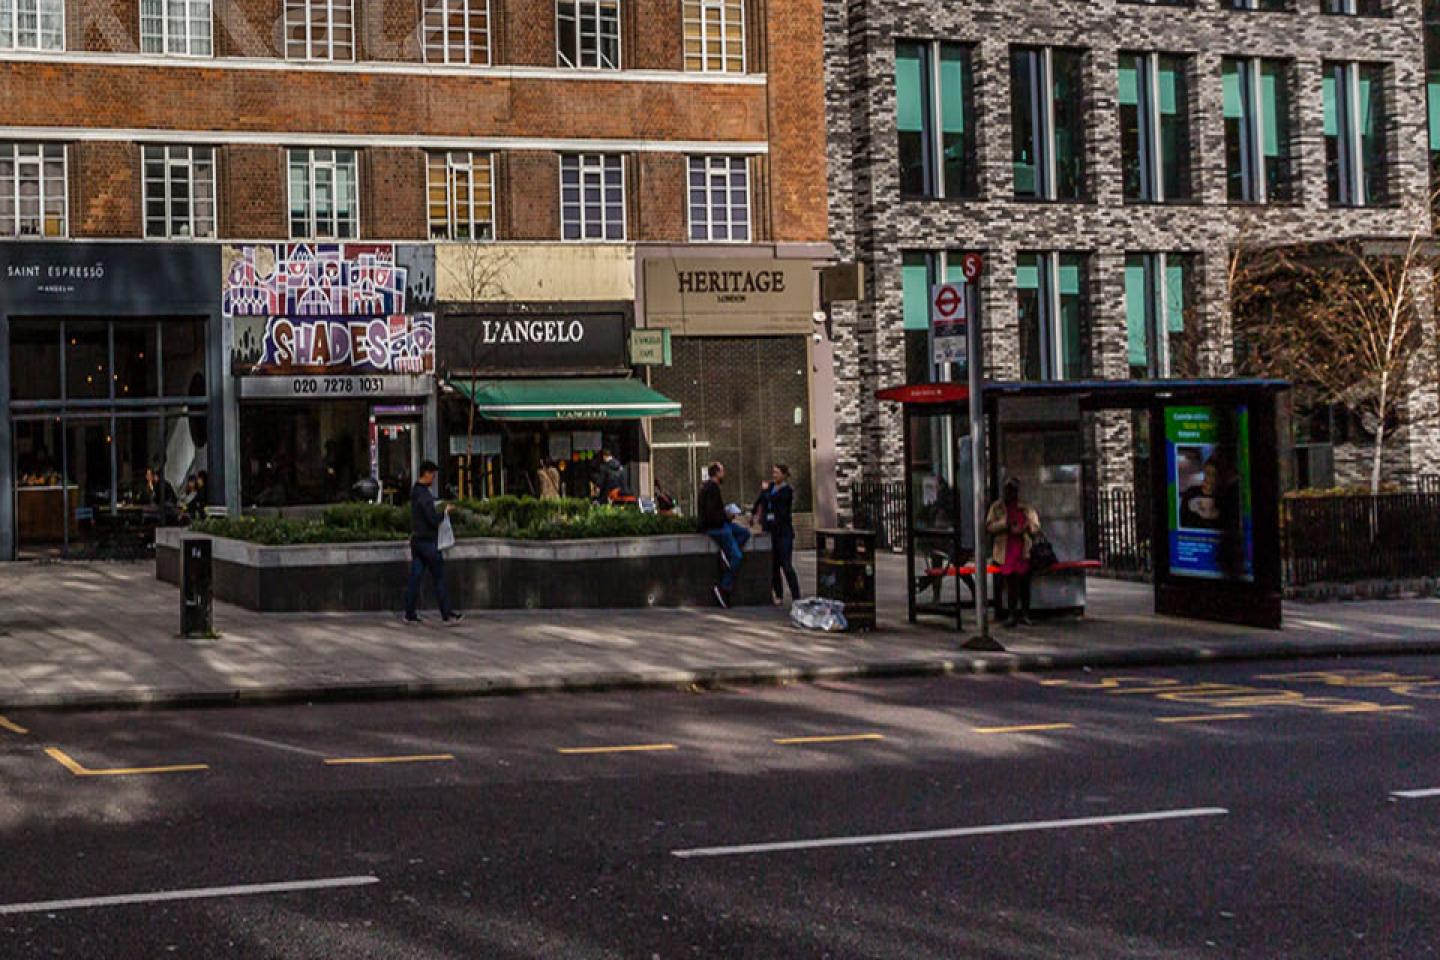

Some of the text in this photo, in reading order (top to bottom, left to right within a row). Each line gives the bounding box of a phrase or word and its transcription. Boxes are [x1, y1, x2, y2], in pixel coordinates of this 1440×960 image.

[7, 265, 40, 277] SAINT
[966, 258, 976, 277] S
[678, 271, 785, 292] HERITAGE
[717, 295, 746, 303] LONDON
[482, 320, 585, 343] L'ANGELO
[273, 318, 389, 368] SHADES
[293, 377, 384, 394] 020 7278 1031
